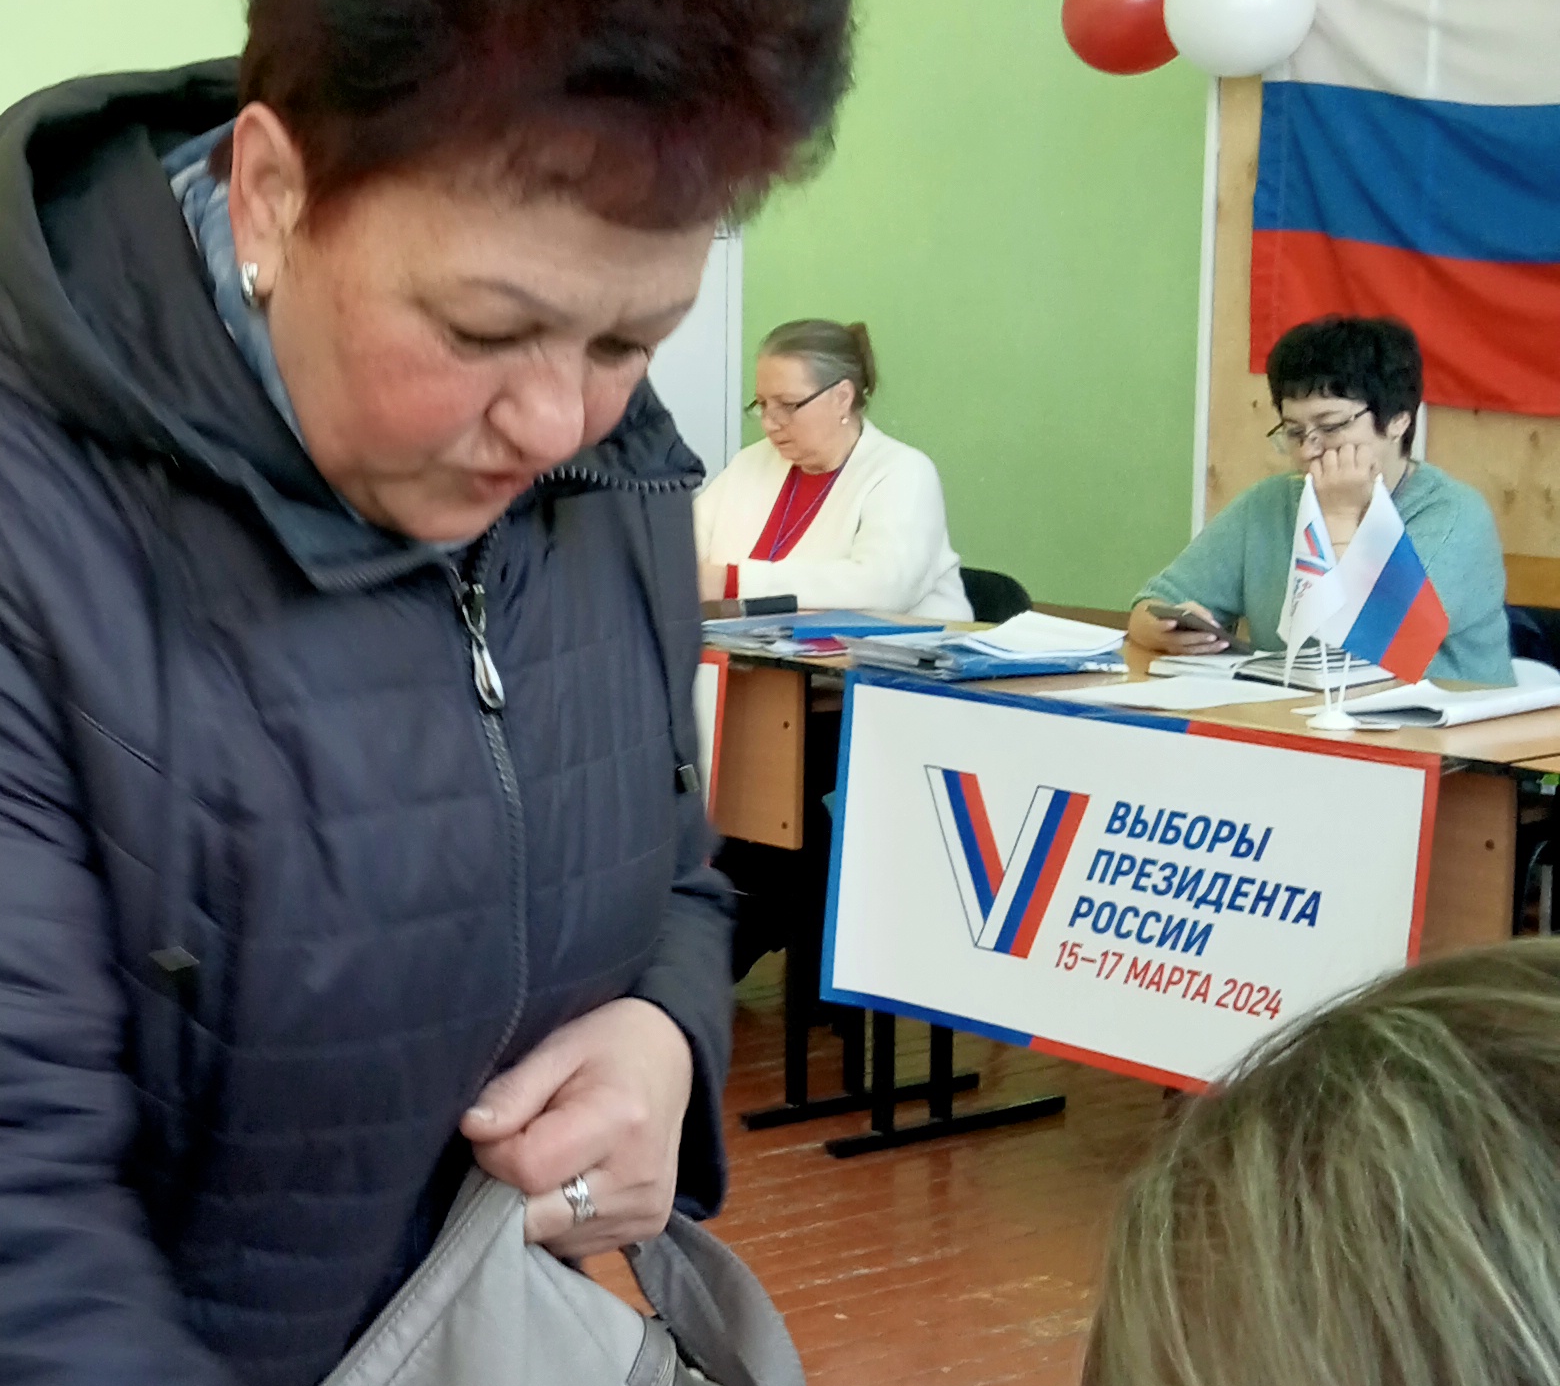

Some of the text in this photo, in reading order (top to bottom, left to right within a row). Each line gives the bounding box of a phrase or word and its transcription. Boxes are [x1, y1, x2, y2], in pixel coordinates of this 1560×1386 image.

[1104, 800, 1275, 862] ВЫБОРЫ
[1086, 847, 1323, 928] ПРЕЗИДЕНТА
[1067, 895, 1215, 957] РОССИИ
[1123, 955, 1213, 1004] МАРТА
[1214, 977, 1284, 1021] 2024
